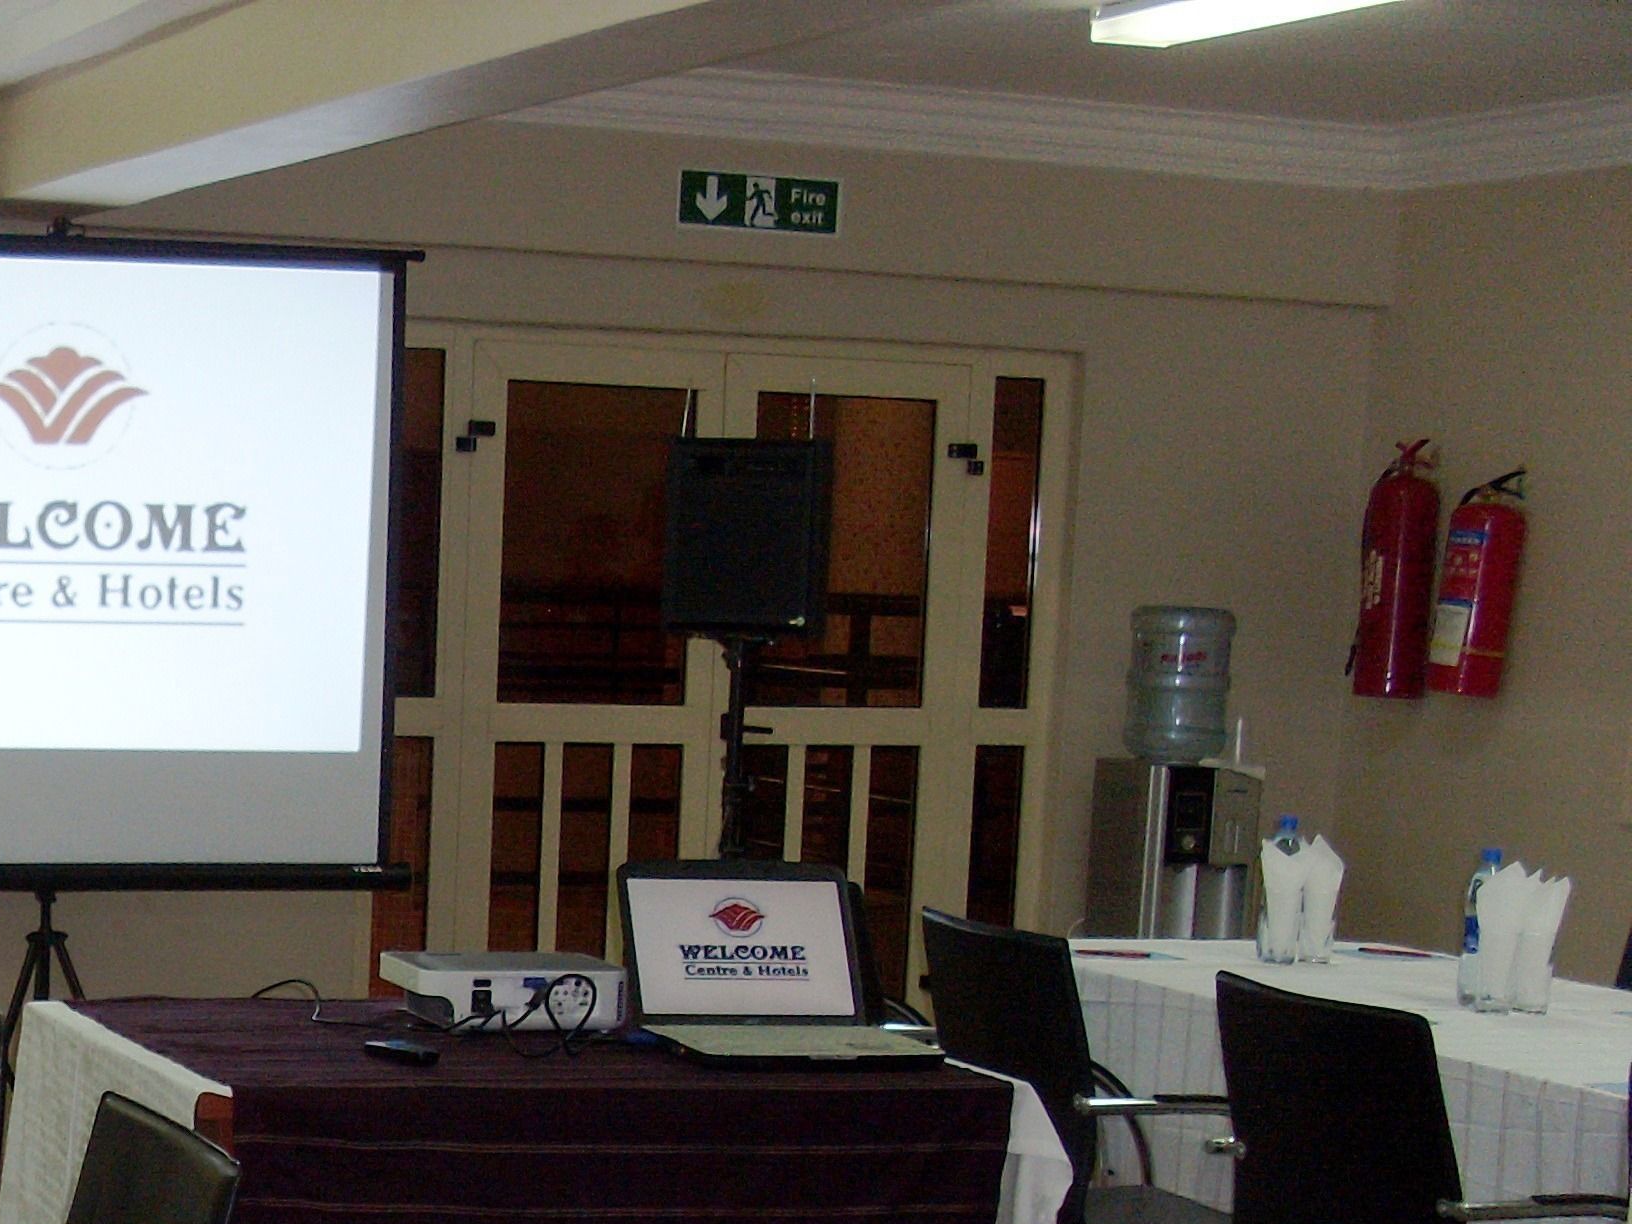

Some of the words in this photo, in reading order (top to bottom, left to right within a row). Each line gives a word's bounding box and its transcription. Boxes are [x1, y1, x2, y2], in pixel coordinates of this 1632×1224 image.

[791, 188, 827, 206] Fire
[791, 211, 824, 225] exit
[52, 572, 78, 609] &
[99, 572, 245, 613] Hotels
[679, 943, 806, 961] WELCOME
[684, 964, 739, 977] Centre
[743, 965, 754, 977] &
[757, 964, 810, 977] Hotels
